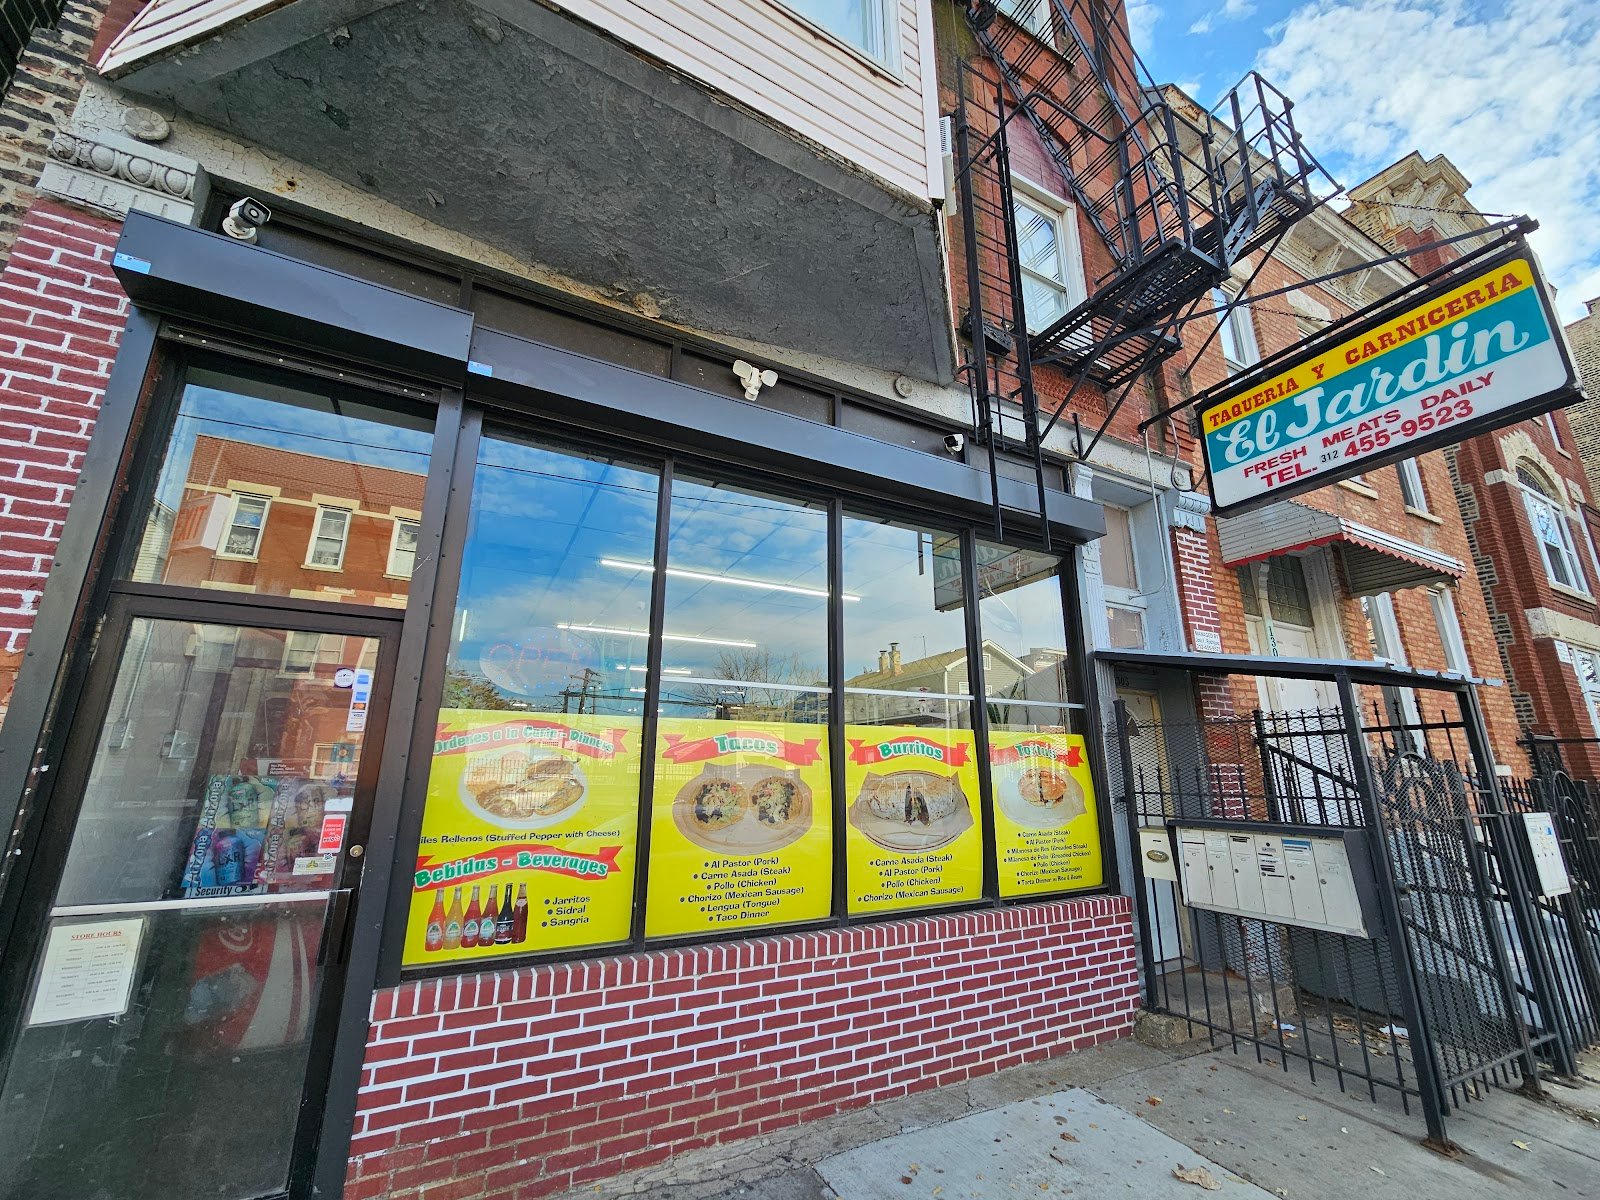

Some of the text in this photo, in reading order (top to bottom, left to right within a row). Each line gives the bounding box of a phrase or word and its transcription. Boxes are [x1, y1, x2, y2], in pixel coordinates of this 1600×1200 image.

[1209, 272, 1522, 427] TAQUERIA Y CARNICERIA
[1216, 320, 1530, 464] El Jardin
[1244, 371, 1494, 478] FRESH MEATS DAILY
[1260, 399, 1474, 488] TEL. 312 455-9523
[433, 730, 489, 754] Ordenes
[568, 728, 614, 753] Dinners
[713, 733, 779, 755] Tacos
[879, 740, 944, 760] Burritos
[441, 834, 483, 844] Rellenos
[486, 832, 527, 843] (Stuffed
[529, 831, 562, 842] Pepper
[565, 830, 584, 839] with
[586, 829, 621, 839] Cheese)
[711, 856, 779, 869] Al Pastor (Pork)
[875, 853, 953, 867] Carne Asada (Steak)
[414, 855, 498, 888] Bebidas
[517, 851, 609, 877] Beverages
[701, 866, 791, 880] Carne Asada (Steak)
[884, 865, 943, 877] Al Pastor (Pork)
[714, 878, 777, 890] Pollo (Chicken)
[886, 877, 941, 889] Pollo (Chicken)
[194, 885, 233, 897] Security
[687, 886, 804, 903] Chorizo (Mexican Sausage)
[863, 886, 964, 902] Chorizo (Mexican Sausage)
[552, 895, 591, 905] Jarritos
[707, 898, 780, 913] Lengua (Tongue)
[555, 906, 586, 915] Sidral
[716, 910, 770, 922] Taco Dinner
[550, 916, 590, 928] Sangria
[71, 930, 122, 941] STORE HOURS
